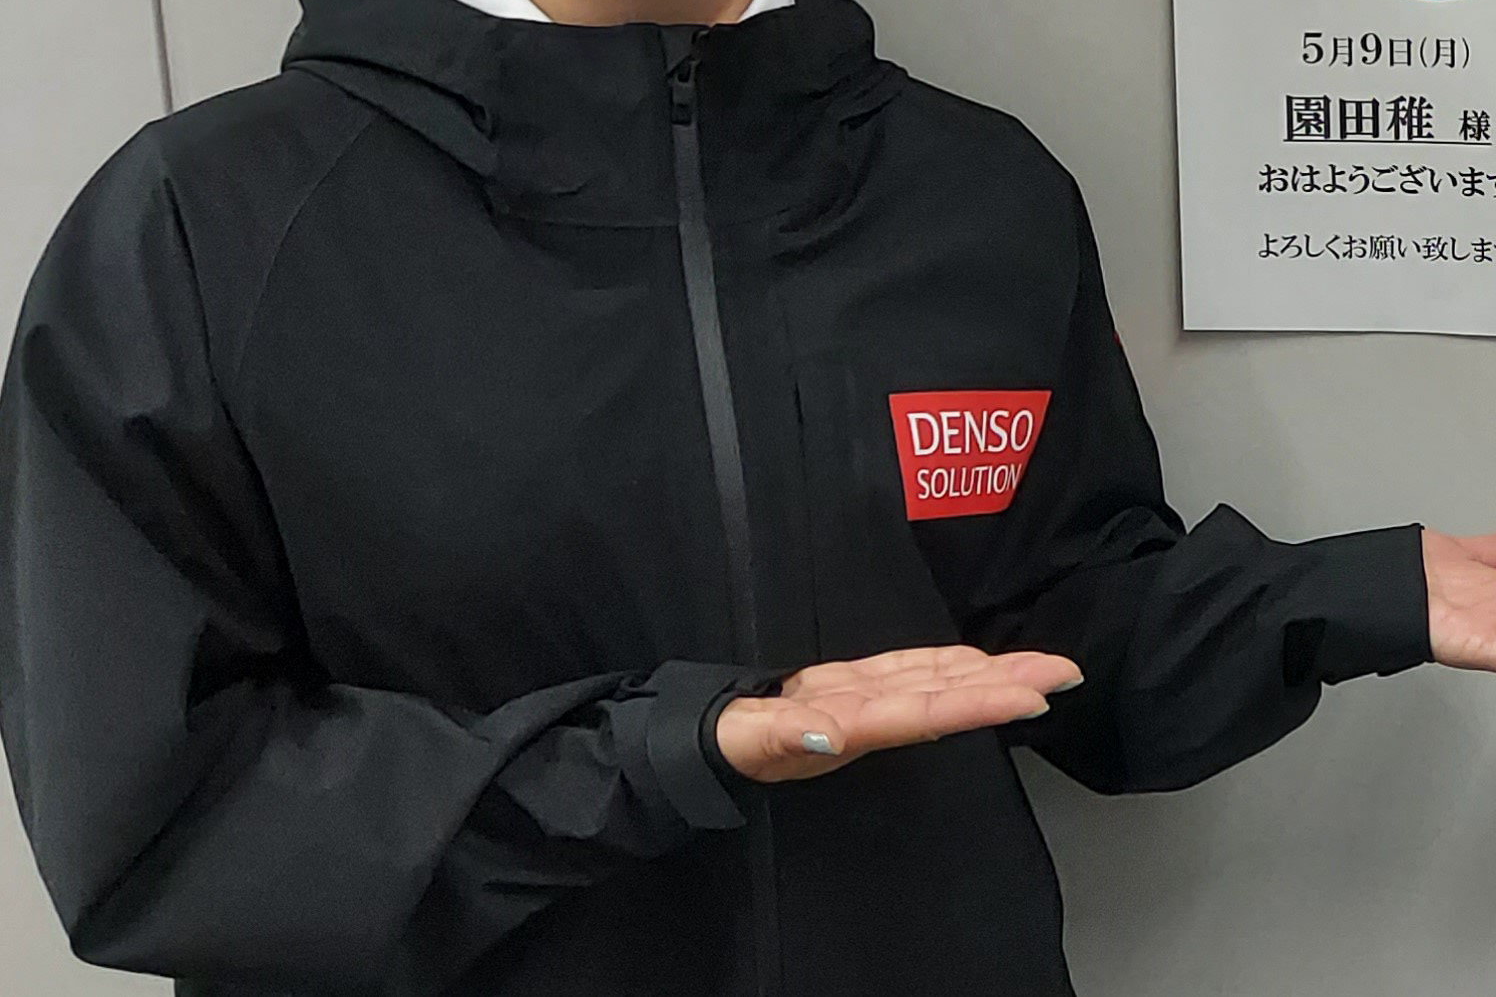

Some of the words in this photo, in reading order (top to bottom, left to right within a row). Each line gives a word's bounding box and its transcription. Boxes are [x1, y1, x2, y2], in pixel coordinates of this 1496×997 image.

[1302, 31, 1470, 69] 5月9日(月)
[1286, 95, 1435, 141] 園田稚
[1459, 110, 1491, 141] 様
[907, 409, 1034, 456] DENSO
[917, 463, 1023, 500] SOLUTION
